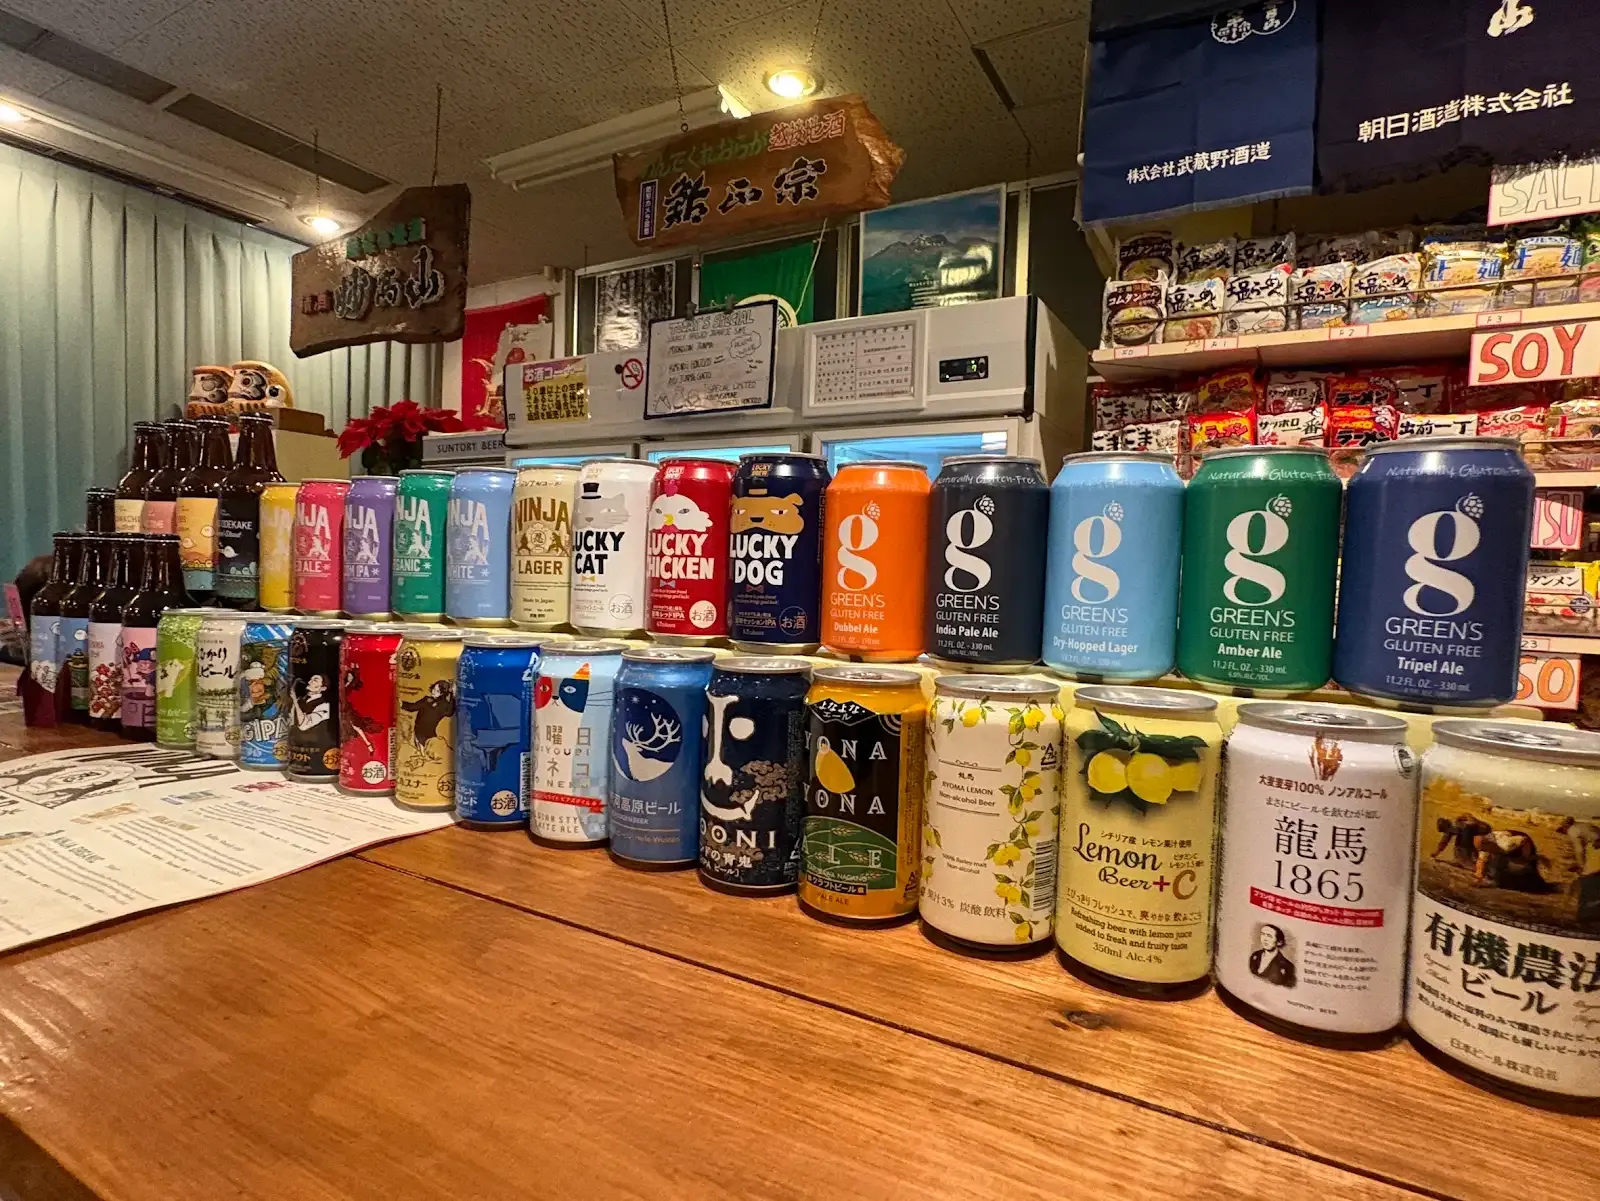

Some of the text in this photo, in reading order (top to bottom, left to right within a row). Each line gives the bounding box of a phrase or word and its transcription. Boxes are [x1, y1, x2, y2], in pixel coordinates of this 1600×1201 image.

[1357, 82, 1576, 143] 朝日酒造株式会社
[1126, 141, 1272, 184] 株式会社武蔵野酒造
[1478, 324, 1588, 383] SOY
[1258, 418, 1300, 429] サッポロ
[1400, 420, 1473, 436] 出前一丁
[437, 443, 476, 454] SUNTORY
[515, 496, 571, 536] NINJA
[648, 533, 709, 556] LUCKY
[729, 533, 799, 559] LUCKY
[303, 561, 323, 573] ALE
[393, 559, 421, 572] GANIC
[449, 565, 475, 579] HITE
[518, 559, 563, 576] LAGER
[574, 553, 608, 575] CAT
[647, 556, 715, 580] HICKEN
[734, 559, 784, 586] DOG
[1529, 572, 1580, 589] タンメン
[610, 602, 633, 614] お酒
[830, 592, 886, 608] GREEN'S
[936, 593, 1000, 611] GREEN'S
[692, 608, 715, 622] お酒
[780, 615, 806, 630] お酒
[830, 608, 885, 621] GLUTEN FREE
[936, 611, 1000, 624] GLUTEN FREE
[1061, 604, 1129, 624] GREEN'S
[1209, 606, 1296, 627] GREEN'S
[834, 621, 879, 634] Dubbel Ale
[936, 624, 999, 638] India Pale Ale
[1061, 623, 1129, 638] GLUTEN FREE
[1209, 626, 1295, 643] GLUTEN FREE
[1385, 616, 1484, 641] GREEN'S
[1053, 635, 1139, 656] Dry-Hopped Lager
[1217, 642, 1283, 659] Amber Ale
[1383, 638, 1483, 658] GLUTEN FREE
[1259, 664, 1275, 674] 330
[1397, 656, 1465, 675] Tripel Ale
[1516, 656, 1575, 704] SO
[819, 700, 861, 715] よなよな
[823, 711, 852, 721] エール
[804, 730, 888, 762] YONA
[363, 764, 385, 779] お酒
[942, 780, 994, 797] RYOMA LEMON
[1259, 774, 1389, 800] 大麦麦芽100% ノンアルコール
[491, 795, 517, 810] お酒
[613, 791, 682, 815] 河高原ビール
[802, 781, 886, 816] YONA
[939, 790, 997, 808] Non-alcohol Beer
[700, 817, 776, 849] OONI
[1101, 830, 1193, 849] シチリア産 レモン果汁使用
[1273, 815, 1368, 866] 龍馬
[802, 834, 883, 869] ALE
[1072, 822, 1163, 872] Lemon
[812, 877, 857, 894] クラフトビール
[1273, 859, 1365, 903] 1865
[959, 901, 1006, 919] 炭酸飲料
[1070, 906, 1106, 930] Refreshing
[1106, 921, 1128, 934] beer
[1128, 927, 1148, 938] with
[1148, 929, 1175, 939] lemon
[1092, 941, 1123, 959] 350ml
[1097, 931, 1106, 940] to
[1106, 933, 1128, 946] fresh
[1128, 940, 1146, 949] and
[1146, 941, 1170, 953] fruity
[1424, 911, 1600, 994] 有機農法
[1460, 967, 1560, 1015] ビール
